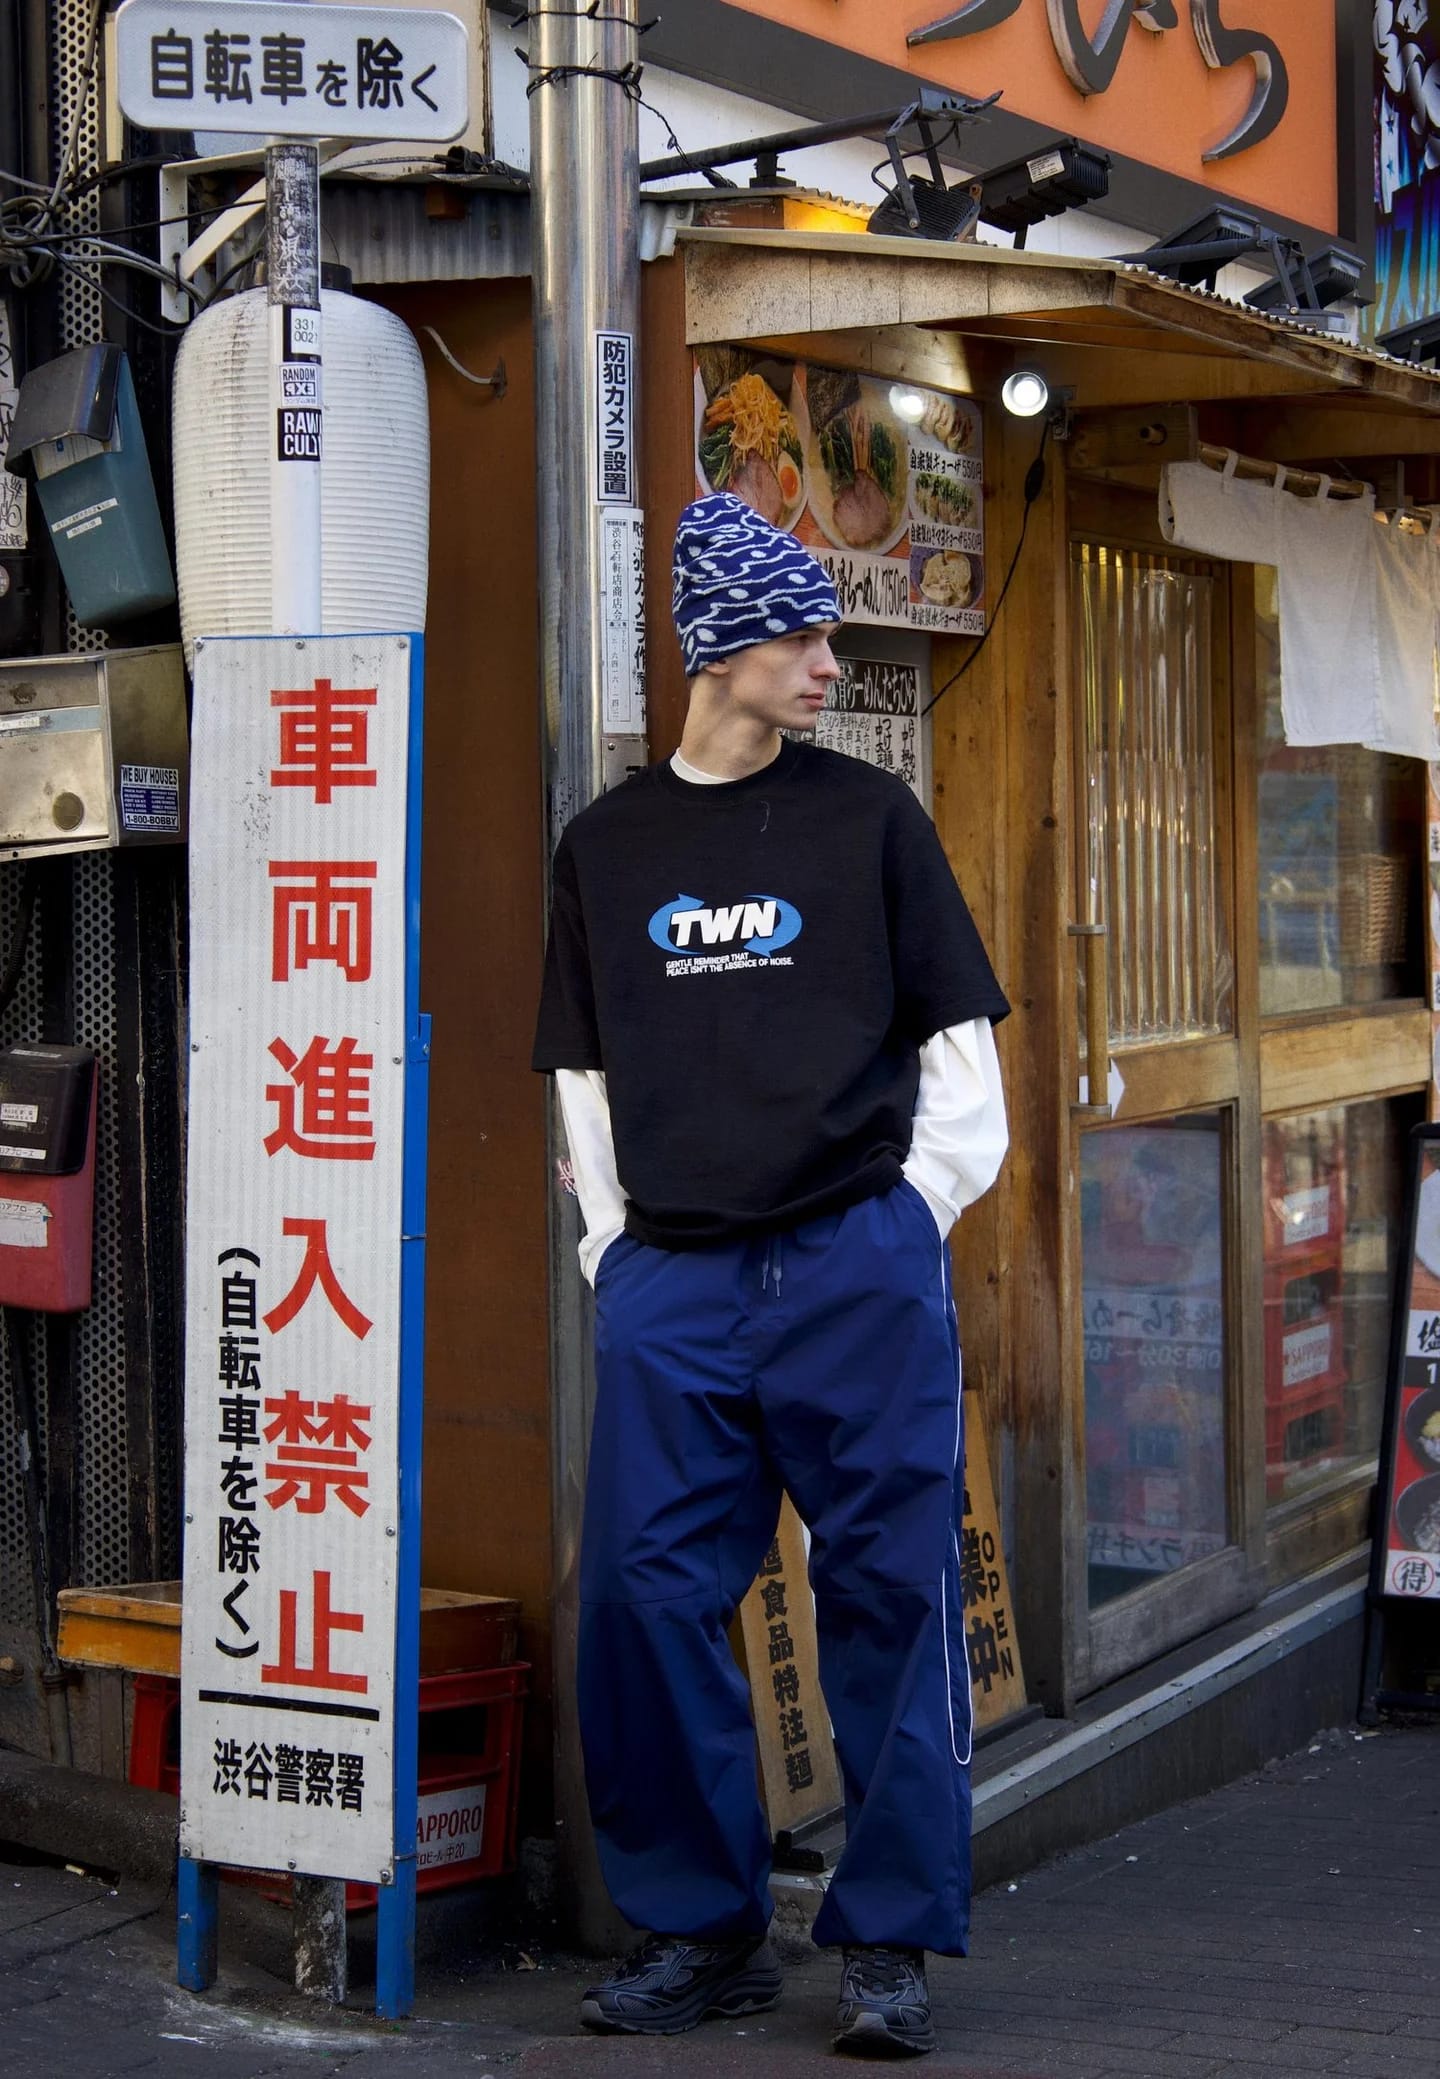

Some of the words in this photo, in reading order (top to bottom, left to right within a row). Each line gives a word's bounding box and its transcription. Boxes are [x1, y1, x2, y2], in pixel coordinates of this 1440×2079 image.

[151, 27, 439, 112] 自転車を除く
[282, 368, 316, 382] RANDOM
[603, 340, 627, 495] 防犯カメラ設置
[134, 768, 148, 783] BUY
[150, 769, 177, 786] HOUSES
[666, 958, 692, 969] GENTLE
[694, 955, 730, 966] REMINDER
[731, 952, 750, 962] THAT
[671, 901, 777, 947] TWN
[666, 967, 689, 977] PEACE
[710, 963, 724, 973] THE
[724, 959, 758, 971] ABSENCE
[758, 958, 769, 967] OF
[261, 679, 378, 1694] 車両進入禁止
[215, 1247, 261, 1659] （自転車を除く）
[981, 1531, 1014, 1681] OPEN
[213, 1739, 365, 1814] 渋谷警察署
